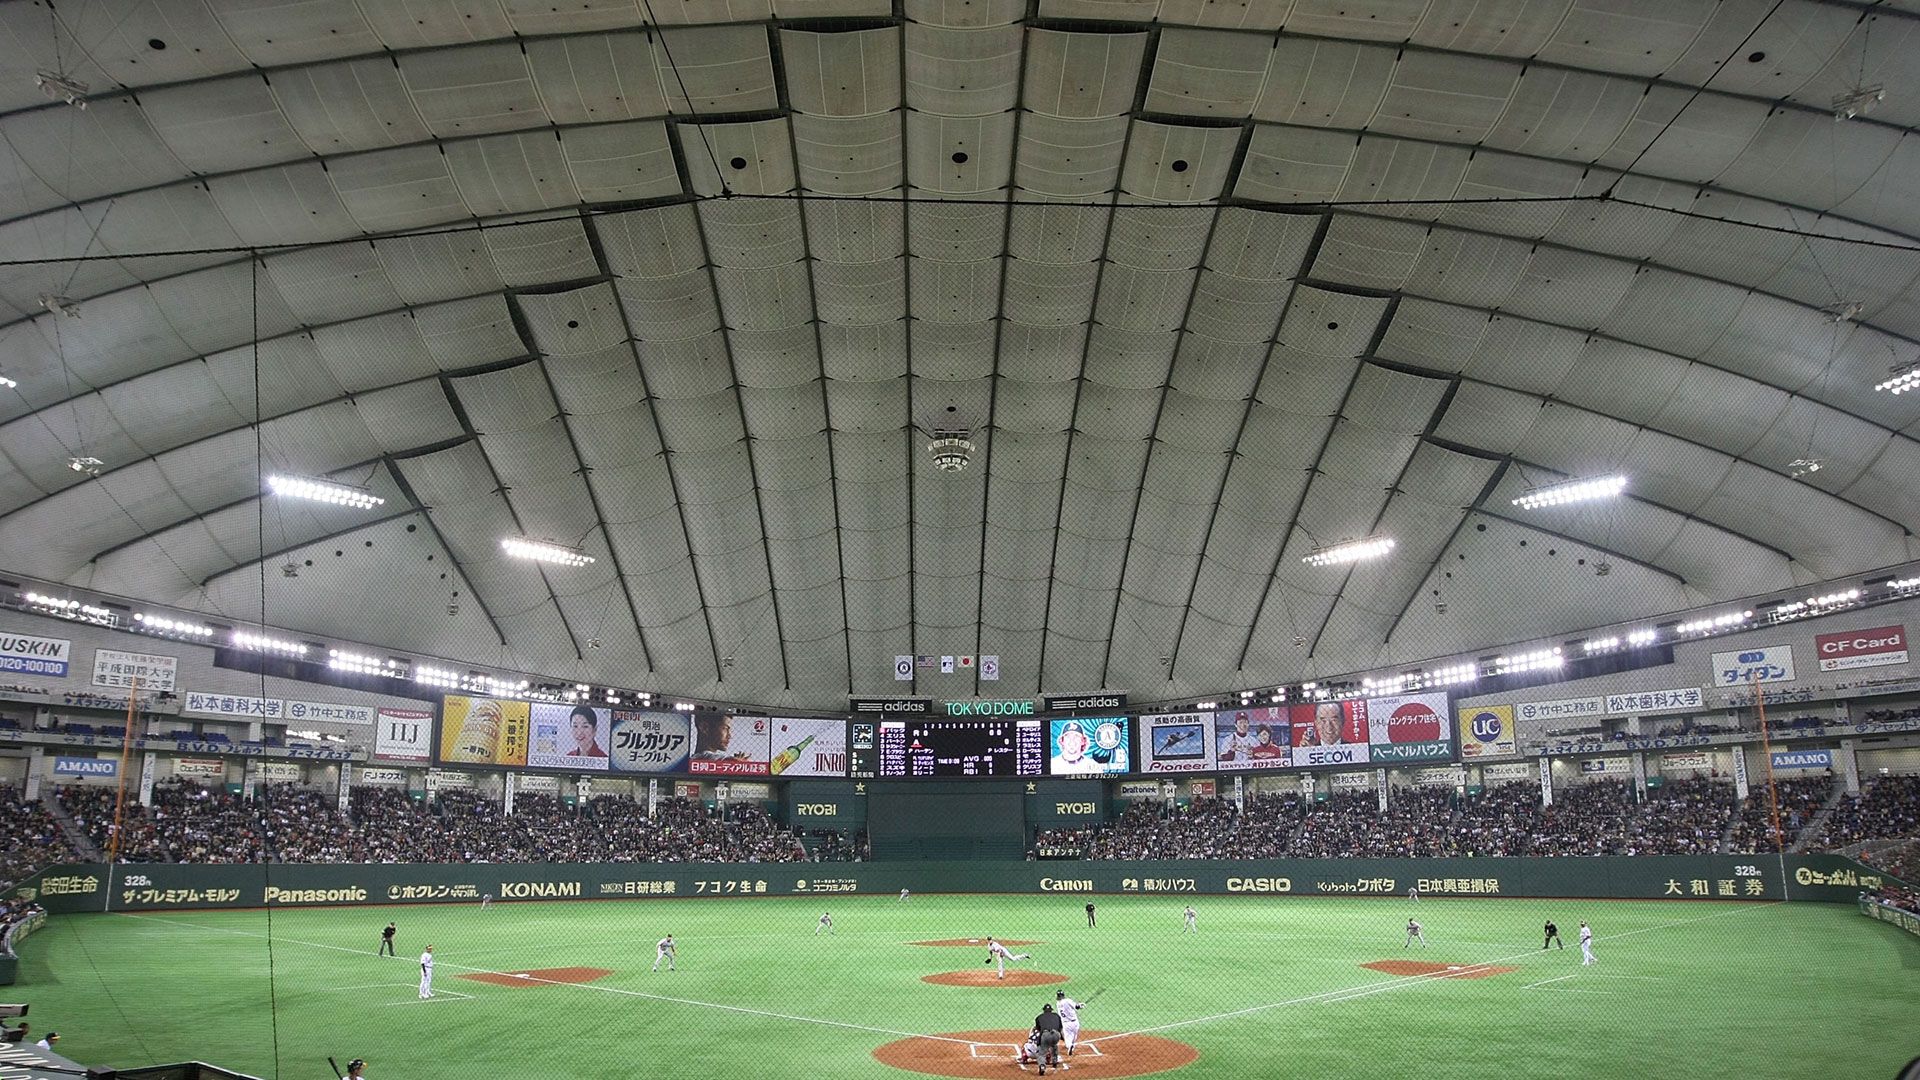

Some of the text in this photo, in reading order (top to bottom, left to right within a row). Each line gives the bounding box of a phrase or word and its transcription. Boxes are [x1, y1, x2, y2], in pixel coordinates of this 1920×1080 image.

[0, 637, 62, 657] USKIN
[1823, 634, 1900, 653] CF Card
[1723, 663, 1785, 683] ダイダン
[189, 694, 280, 716] 松本歯科大学
[884, 702, 925, 712] adidas
[1078, 697, 1119, 708] adidas
[1610, 690, 1699, 712] 松本歯科大学
[310, 706, 368, 721] 竹中工務店
[945, 702, 1034, 716] TOKYO DOME
[1540, 702, 1598, 716] 竹中工務店
[642, 720, 661, 731] 明治
[1154, 715, 1200, 725] 感動の高画質
[1473, 718, 1500, 735] UC
[390, 722, 419, 744] IIJ
[616, 729, 686, 751] ブルガリア
[629, 750, 672, 763] ヨーグルト
[1309, 751, 1353, 764] SECOM
[1373, 743, 1450, 759] ヘーベルハウス
[812, 753, 846, 772] JINRO
[1773, 753, 1829, 766] AMANO
[57, 761, 113, 773] AMANO
[691, 761, 768, 773] 日興コーディアル証券
[1149, 761, 1210, 772] Pioneer
[1332, 774, 1367, 785] 昭和大学
[797, 804, 837, 815] RYOBI
[1056, 803, 1096, 815] RYOBI
[501, 882, 581, 897] KONAMI
[624, 881, 676, 894] 日研総業
[694, 881, 768, 893] フコク生命
[813, 884, 857, 892] コニカミノルタ
[1040, 878, 1093, 891] Canon
[1143, 879, 1196, 891] 積水ハウス
[1226, 878, 1291, 892] CASIO
[1357, 879, 1395, 892] クボタ
[1417, 879, 1500, 893] 日本興亜損保
[1664, 879, 1764, 896] 大和証券
[123, 888, 240, 904] ザ・プレミアム・モルツ
[264, 885, 367, 903] Panasonic
[402, 885, 449, 898] ホクレン
